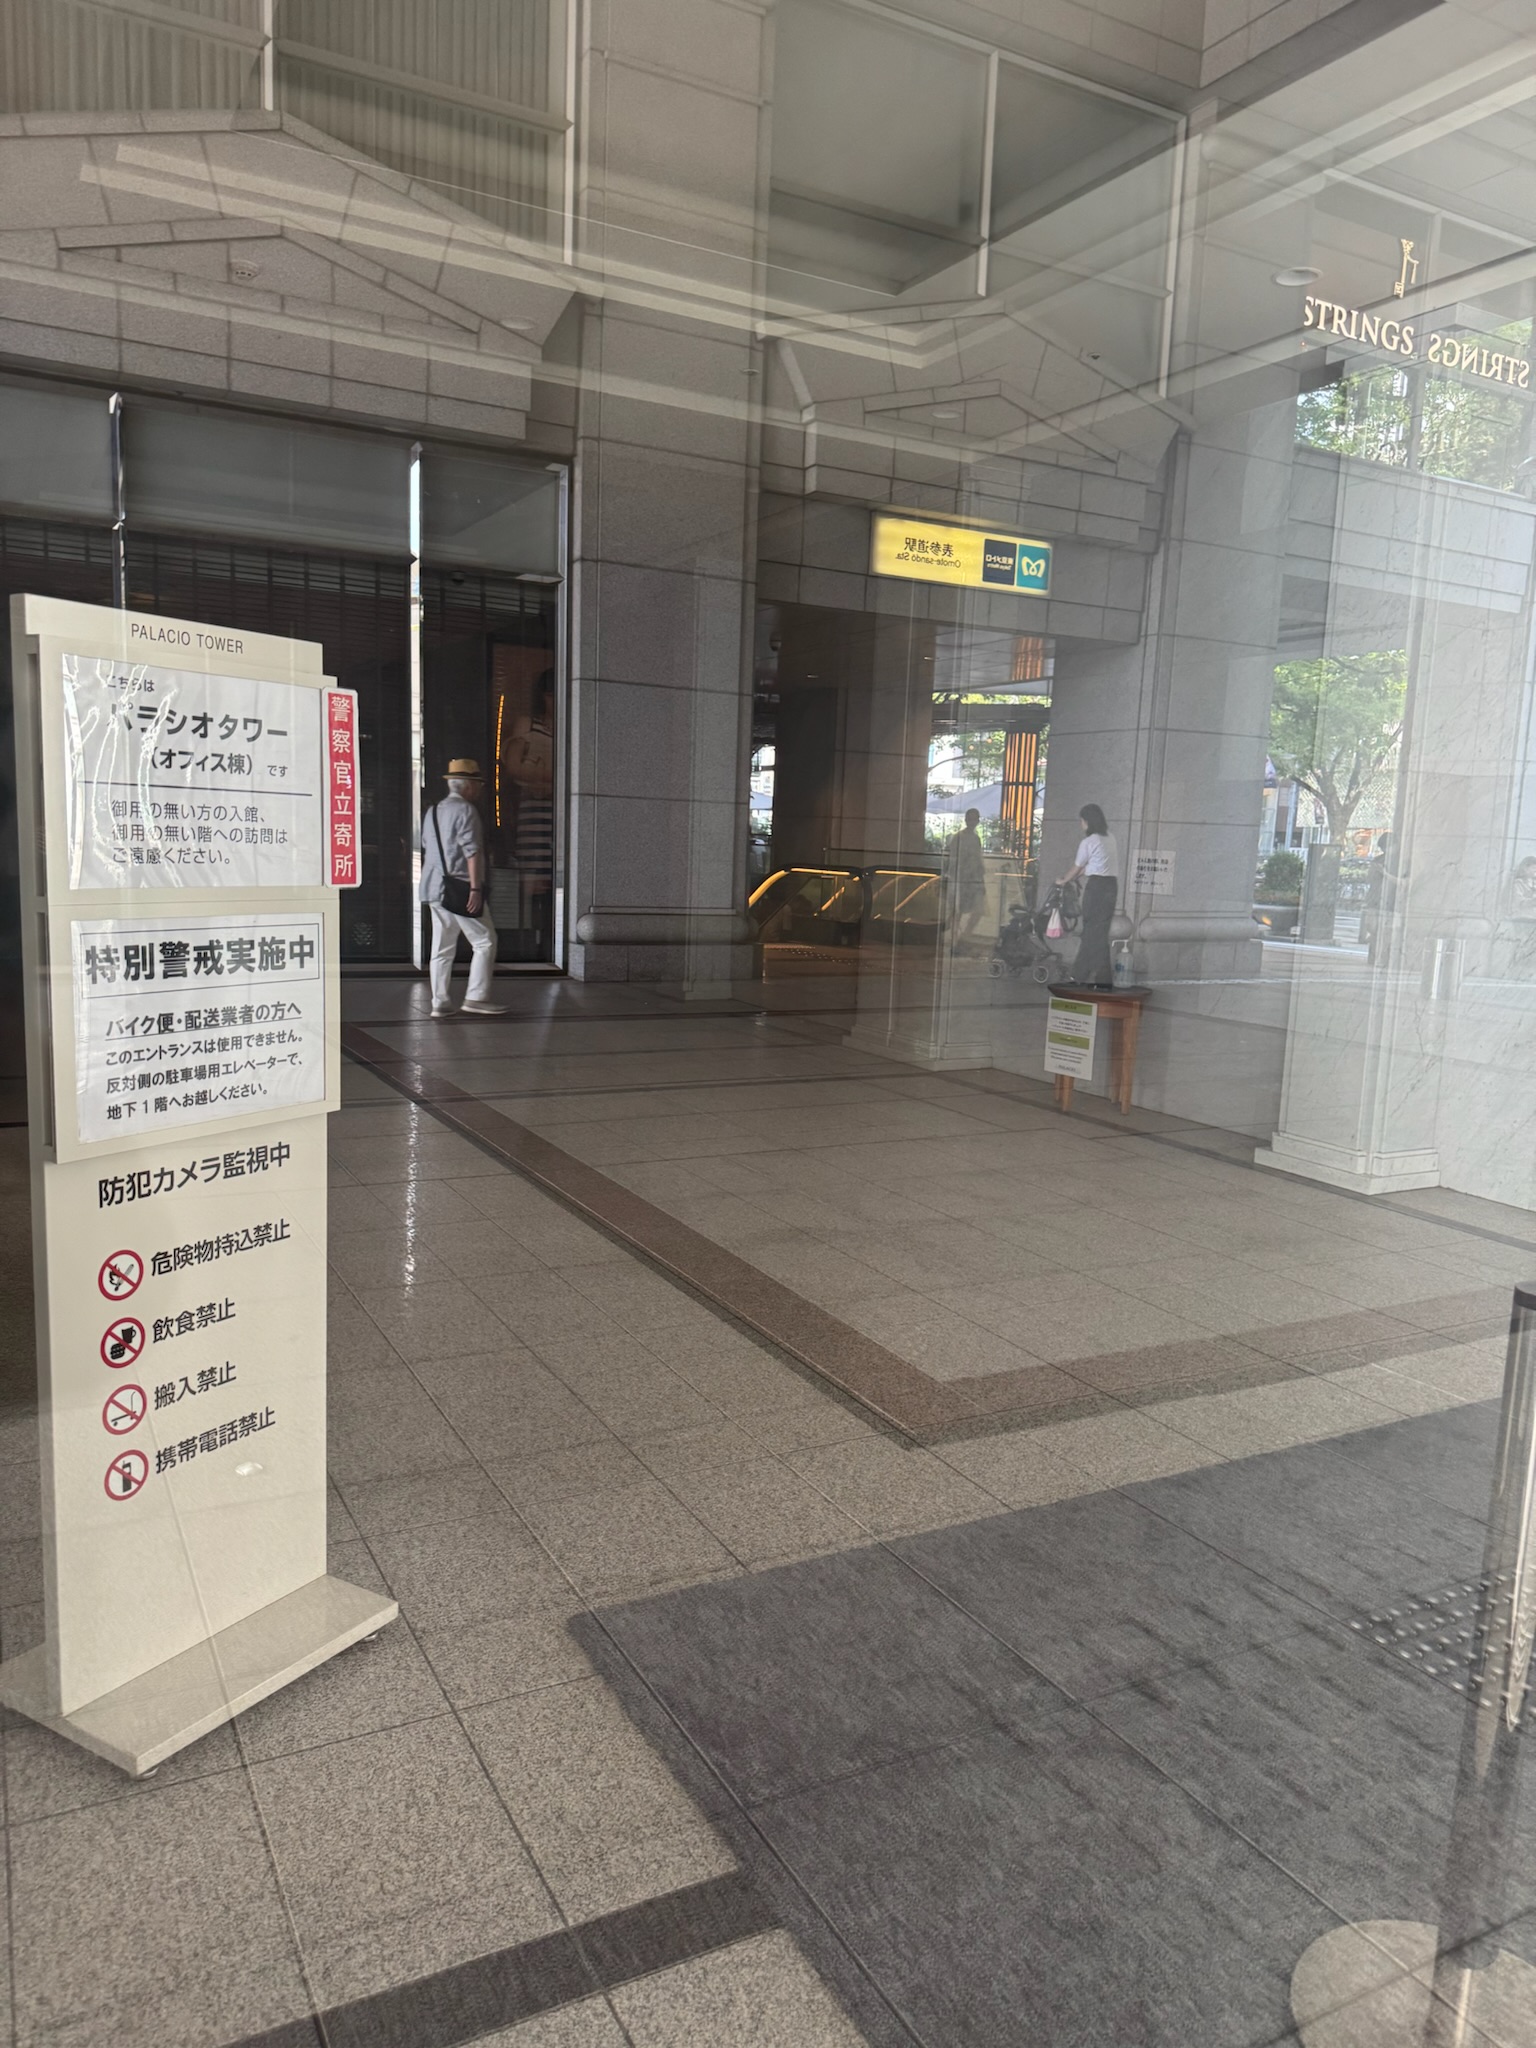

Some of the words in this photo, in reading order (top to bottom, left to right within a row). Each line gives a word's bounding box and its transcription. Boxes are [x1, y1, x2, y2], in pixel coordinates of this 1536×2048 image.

[1303, 296, 1415, 355] STRINGS
[130, 623, 191, 646] PALACIO
[196, 633, 244, 654] TOWER
[150, 746, 253, 776] (オフィス棟)
[267, 764, 288, 778] です
[331, 696, 354, 878] 警察官立寄所
[112, 799, 265, 824] 御用の無い方の入館、
[112, 823, 288, 845] 御用の無い階への訪問は
[112, 846, 231, 866] ご遠慮ください。
[84, 934, 315, 985] 特別警戒実施中
[106, 1001, 302, 1037] バイク便・配送業者の方へ
[106, 1028, 303, 1066] このエントランスは使用できません。
[106, 1053, 303, 1094] 反対側の駐車場用エレベーターで、
[98, 1141, 291, 1208] 防犯カメラ監視中
[150, 1218, 291, 1277] 危険物持込禁止
[152, 1297, 236, 1344] 飲食禁止
[154, 1360, 237, 1410] 搬入禁止
[155, 1406, 276, 1474] 携帯電話禁止
